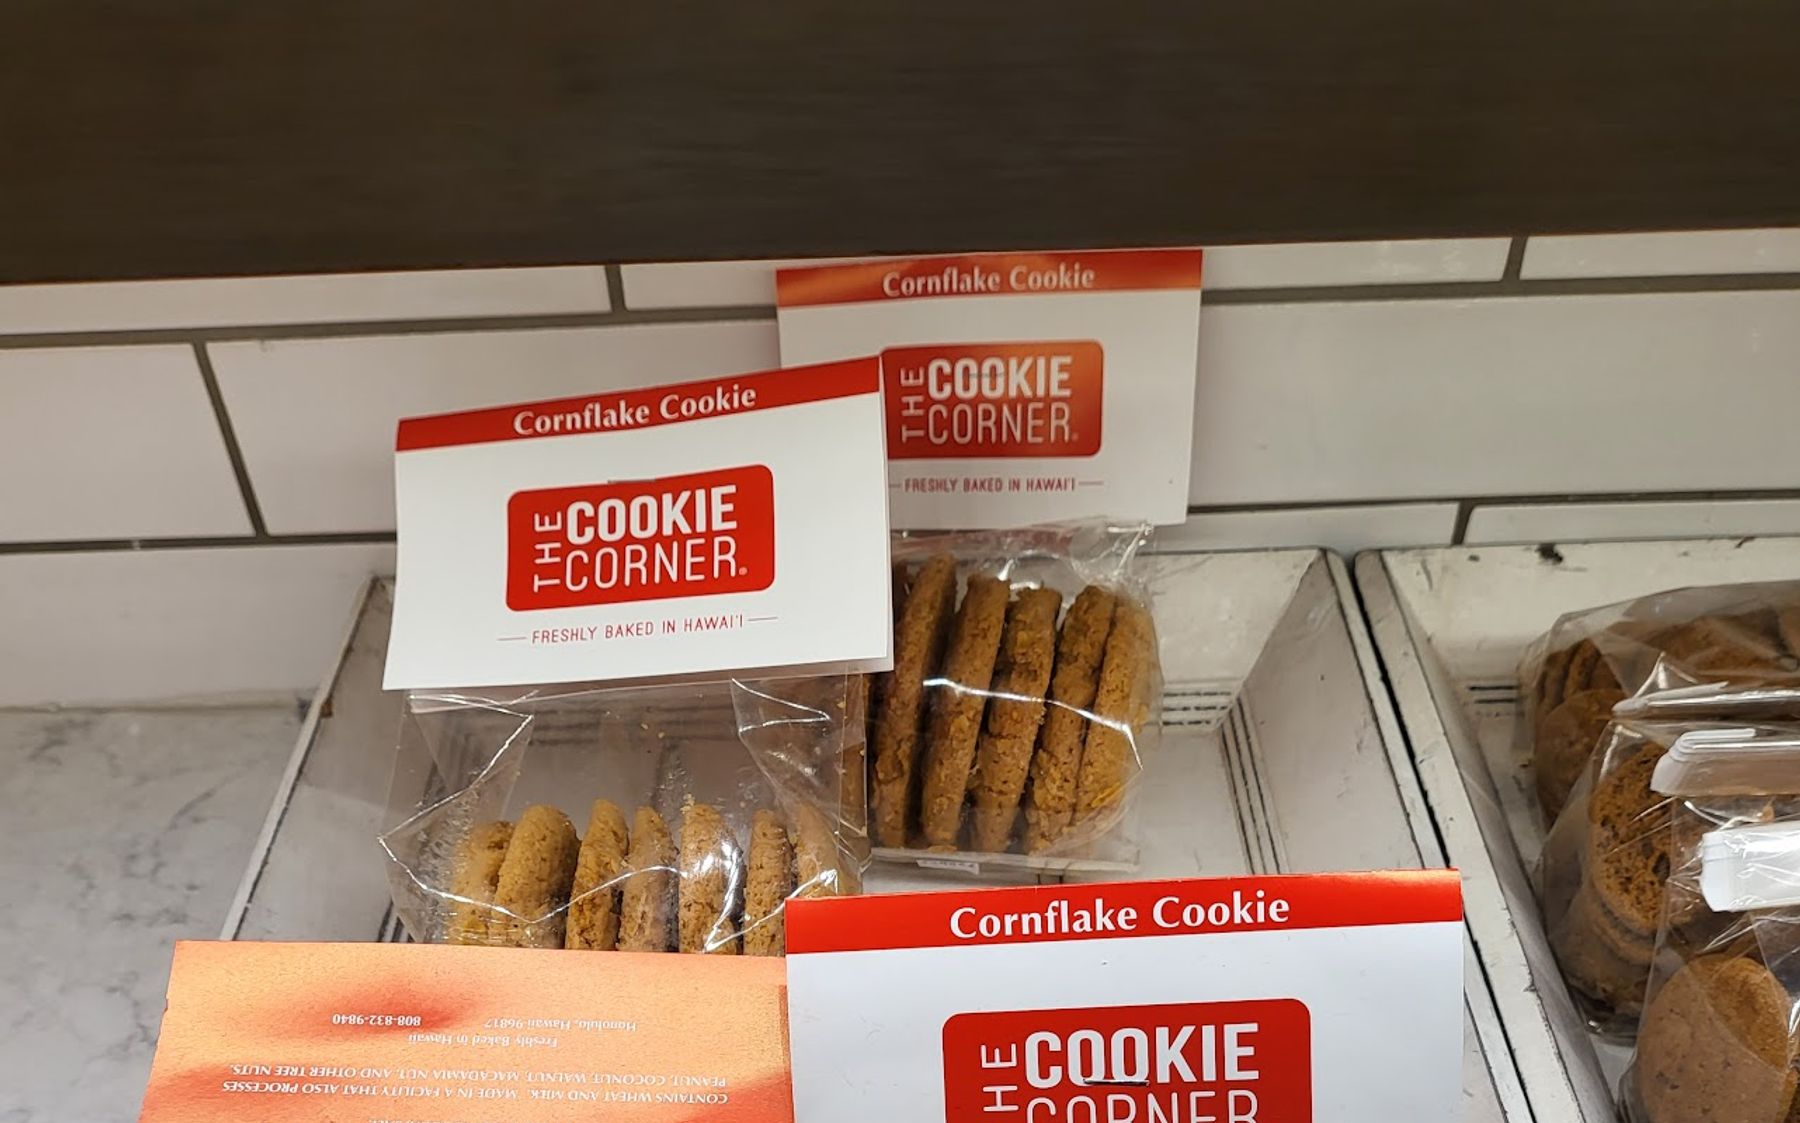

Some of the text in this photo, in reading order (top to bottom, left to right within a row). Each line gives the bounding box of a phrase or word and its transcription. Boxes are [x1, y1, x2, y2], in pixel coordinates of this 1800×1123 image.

[883, 262, 1096, 298] Cornflake Cookie
[928, 355, 1073, 400] COOKIE
[513, 383, 757, 436] Cornflake Cookie
[901, 366, 925, 443] THE
[905, 477, 958, 493] FRESHLY
[963, 477, 1002, 492] BAKED
[1008, 478, 1021, 491] IN
[566, 485, 738, 544] COOKIE
[534, 511, 562, 592] THE
[532, 626, 598, 644] FRESHLY
[605, 621, 654, 639] BAKED
[662, 619, 676, 634] IN
[950, 889, 1290, 939] Cornflake Cookie
[332, 1014, 422, 1026] 808-832-9840
[484, 1018, 524, 1029] 96817
[456, 1034, 469, 1045] in
[473, 1035, 510, 1047] Baked
[515, 1035, 558, 1048] Freshly
[1024, 1022, 1260, 1089] COOKIE
[230, 1064, 273, 1076] NUTS.
[274, 1065, 306, 1077] TREE
[310, 1067, 357, 1078] OTHER
[360, 1068, 391, 1079] AND
[432, 1070, 520, 1081] MACADAMIA
[222, 1081, 299, 1094] PROCESSES
[302, 1083, 340, 1094] ALSO
[341, 1085, 377, 1096] THAT
[380, 1086, 441, 1097] FACILITY
[444, 1087, 453, 1097] A
[457, 1087, 473, 1098] IN
[477, 1088, 519, 1099] MADE
[567, 1090, 600, 1101] AND
[603, 1091, 652, 1103] WHEAT
[655, 1093, 728, 1105] CONTAINS
